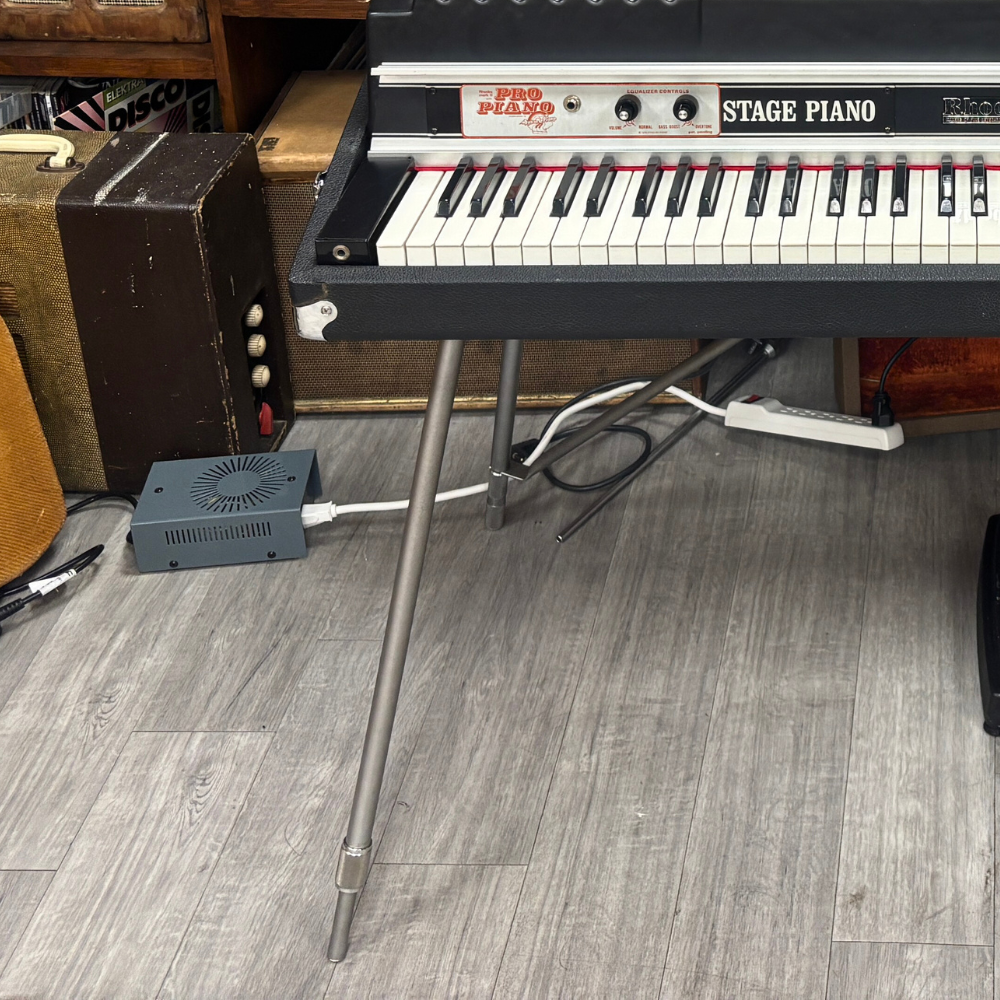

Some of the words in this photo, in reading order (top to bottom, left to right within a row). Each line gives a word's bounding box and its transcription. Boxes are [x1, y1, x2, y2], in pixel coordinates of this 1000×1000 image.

[106, 78, 145, 103] ELEKTRA
[494, 88, 543, 101] PRO
[108, 78, 185, 132] DISCO
[477, 101, 556, 115] PIANO
[723, 99, 797, 123] STAGE
[805, 100, 876, 123] PIANO
